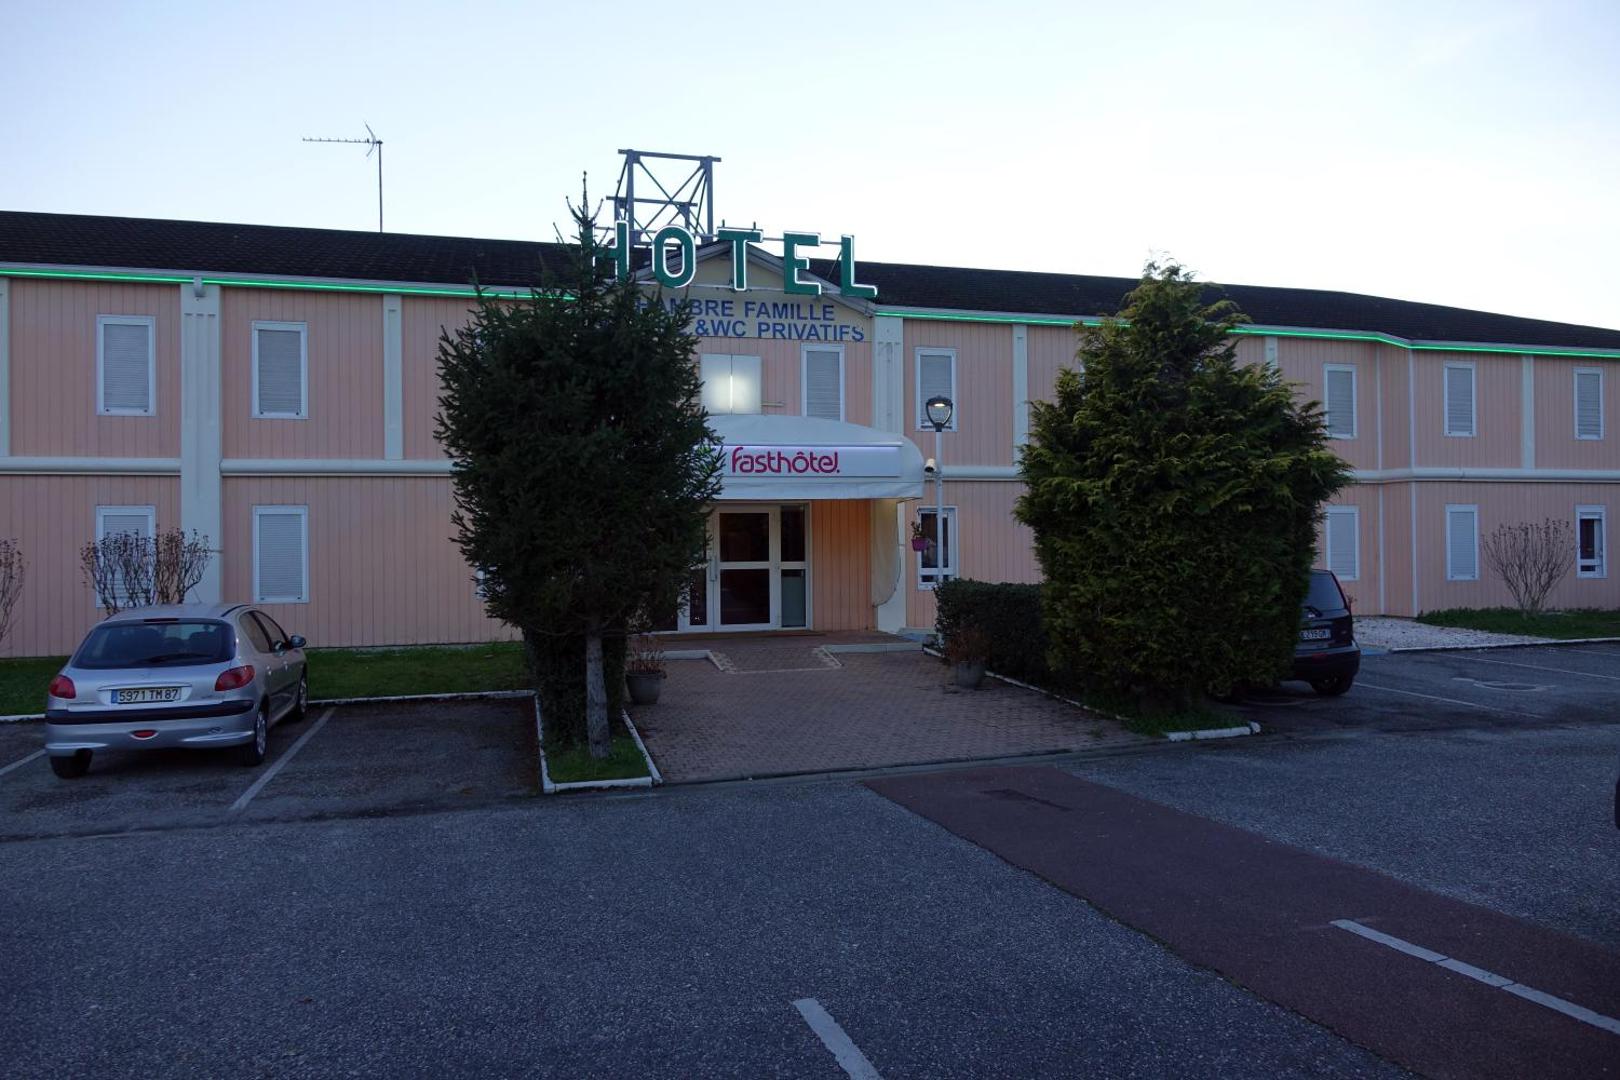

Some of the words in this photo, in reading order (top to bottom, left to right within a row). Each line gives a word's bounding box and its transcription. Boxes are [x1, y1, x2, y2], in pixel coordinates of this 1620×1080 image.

[582, 220, 878, 297] HOTEL
[744, 301, 835, 321] FAMILLE
[757, 322, 865, 342] PRIVATIFS
[119, 689, 146, 702] 5971
[164, 688, 178, 700] 87
